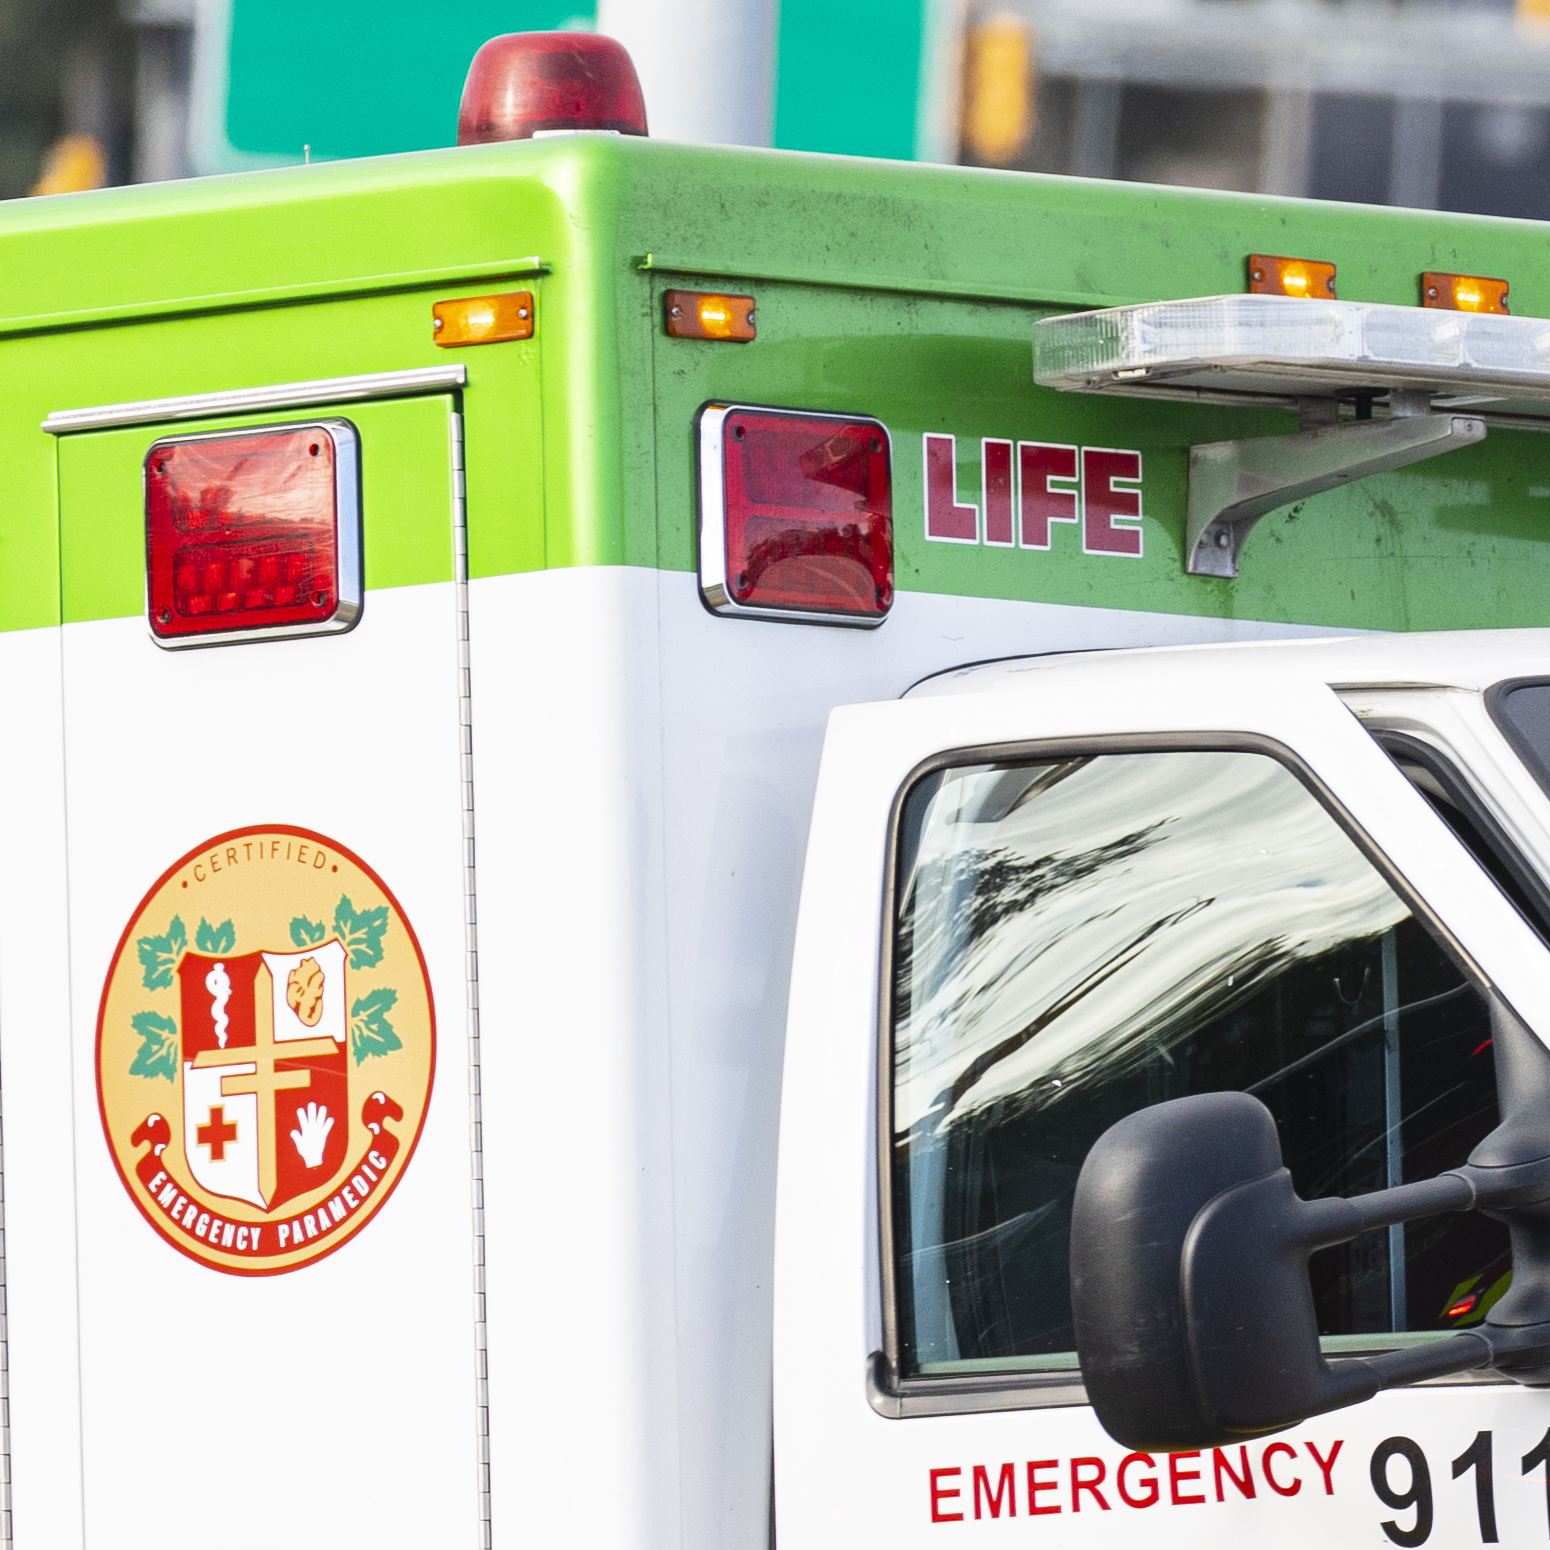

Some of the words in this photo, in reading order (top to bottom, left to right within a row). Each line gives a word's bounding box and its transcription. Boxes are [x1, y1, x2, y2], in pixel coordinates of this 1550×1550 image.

[922, 432, 1143, 558] LIFE
[193, 841, 326, 882] CERTIFIED
[148, 1171, 261, 1250] EMERGENCY
[277, 1151, 387, 1248] PARAMEDIC
[929, 1440, 1345, 1523] EMERGENCY
